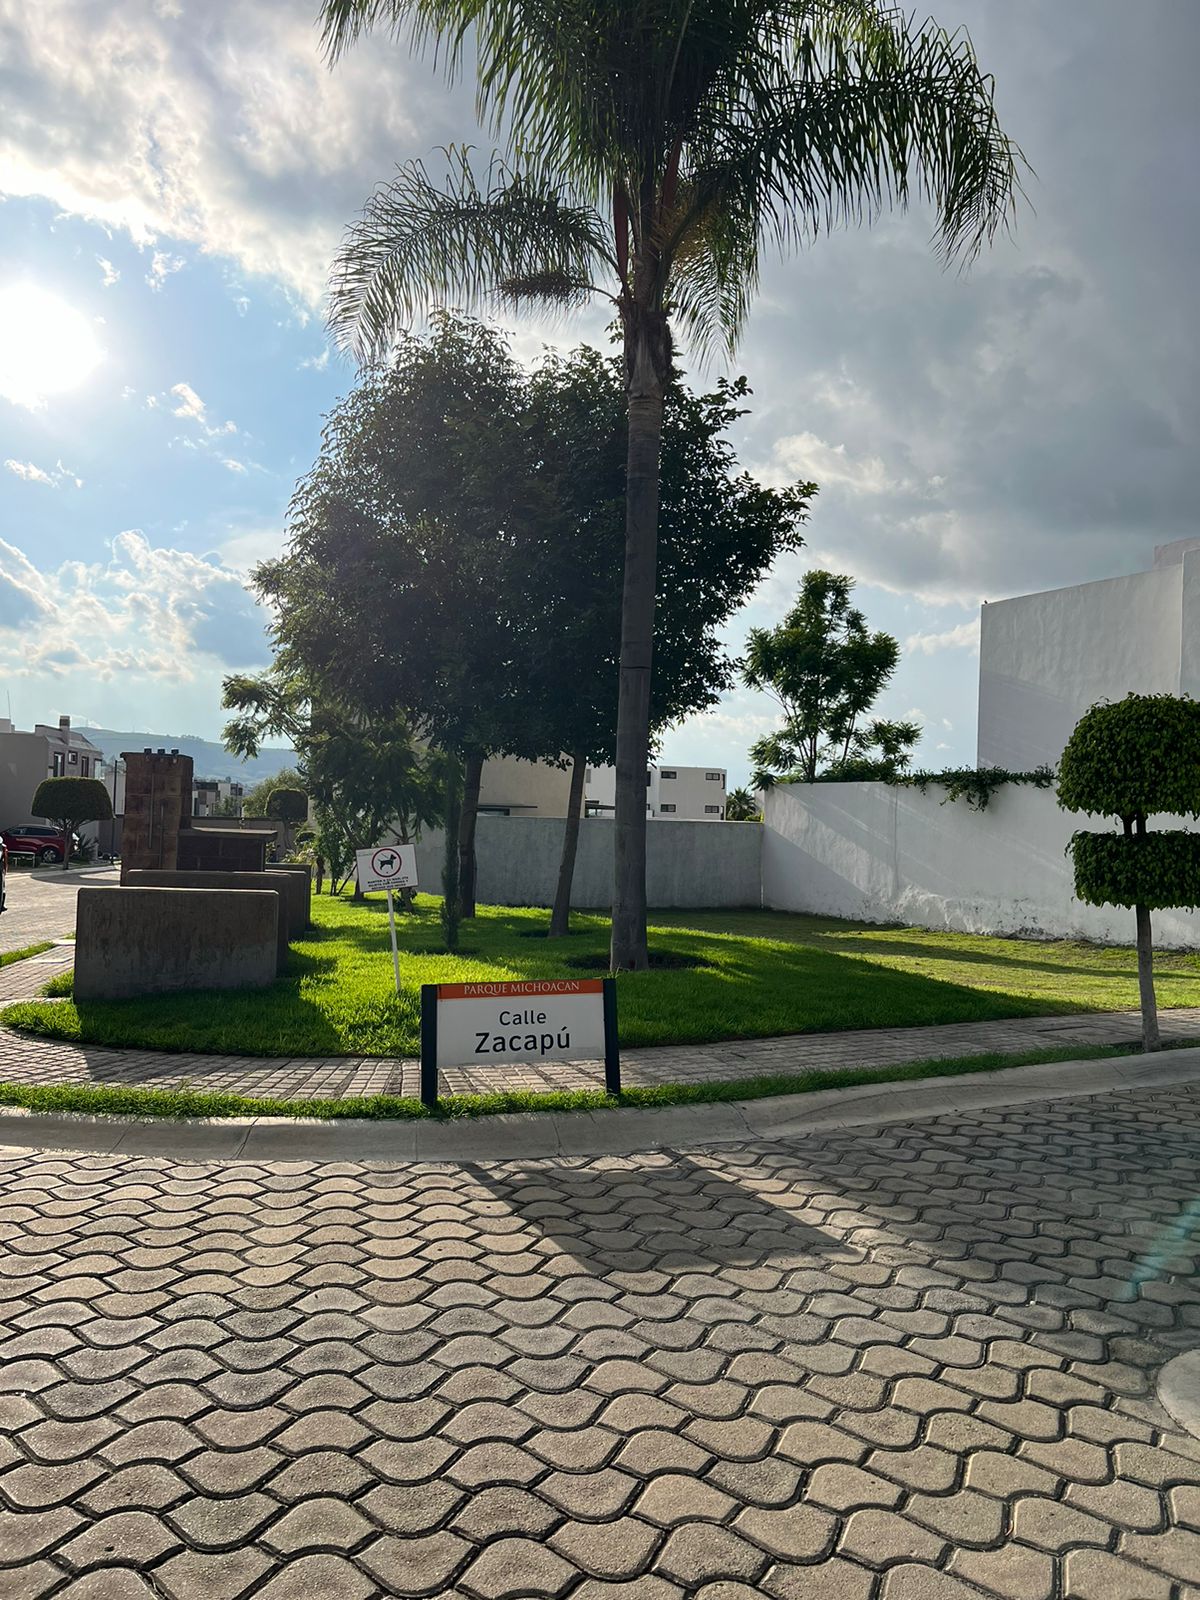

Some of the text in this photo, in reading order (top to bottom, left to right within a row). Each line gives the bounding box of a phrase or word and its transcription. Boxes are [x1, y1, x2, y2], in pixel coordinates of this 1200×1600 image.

[464, 981, 580, 995] PARQUE MICHOACAN
[499, 1010, 547, 1026] Calle
[475, 1026, 570, 1055] Zacapú
